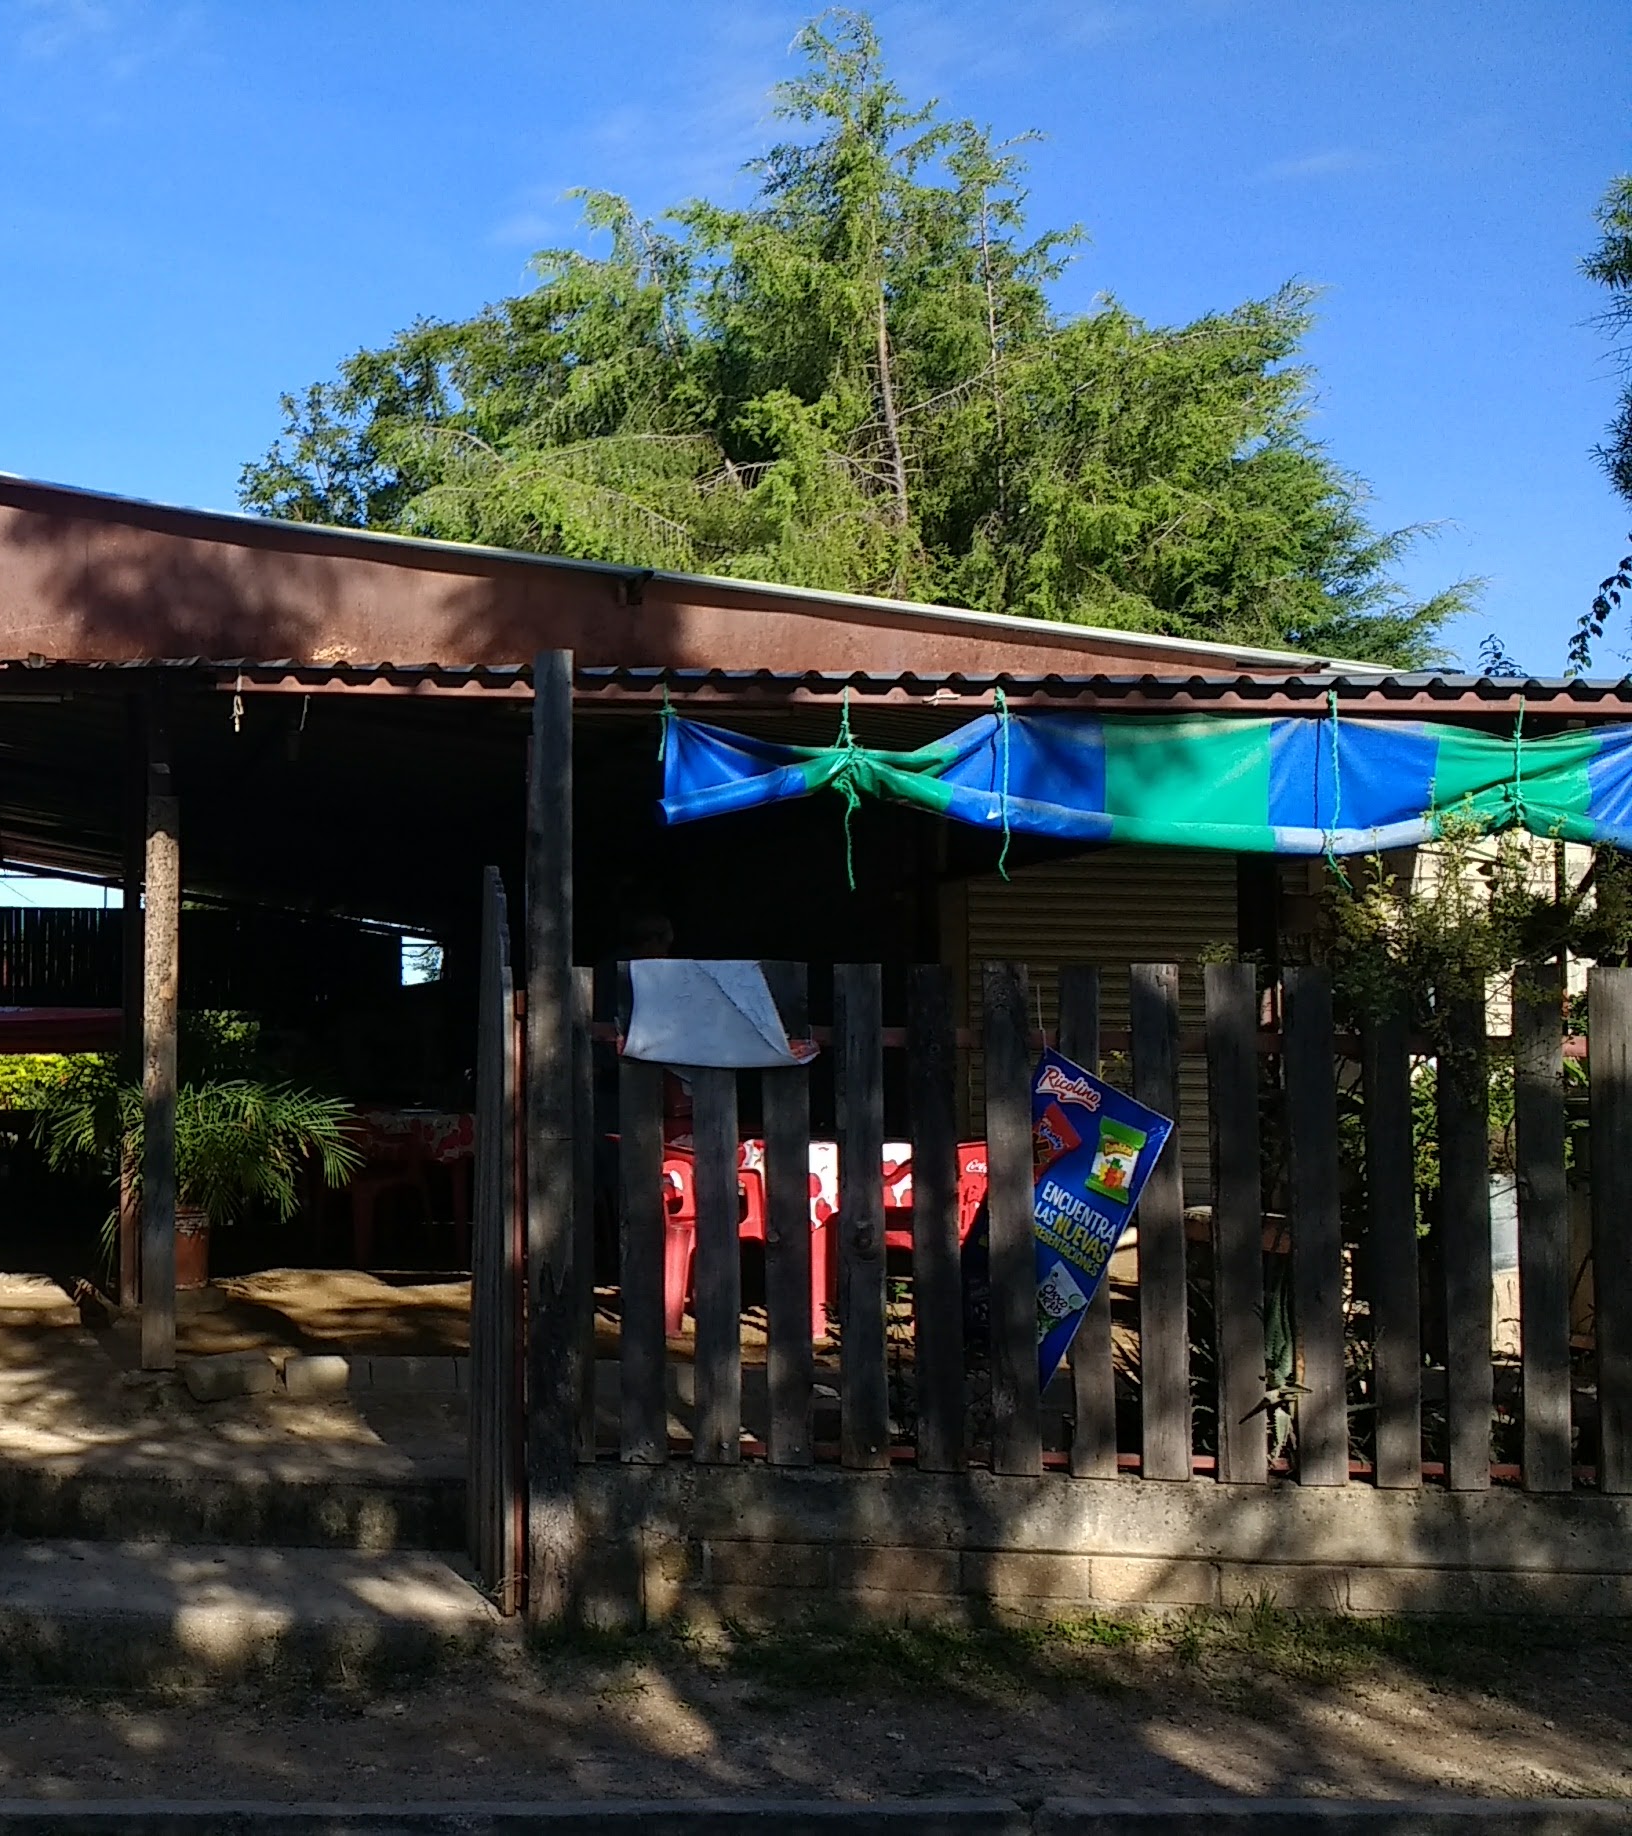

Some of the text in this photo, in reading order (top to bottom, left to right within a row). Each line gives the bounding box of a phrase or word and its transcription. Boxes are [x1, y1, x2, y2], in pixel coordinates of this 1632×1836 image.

[1038, 1065, 1100, 1104] Ricolino
[1034, 1201, 1111, 1265] LAS NUEVAS
[1042, 1180, 1117, 1244] ENCUENTRA
